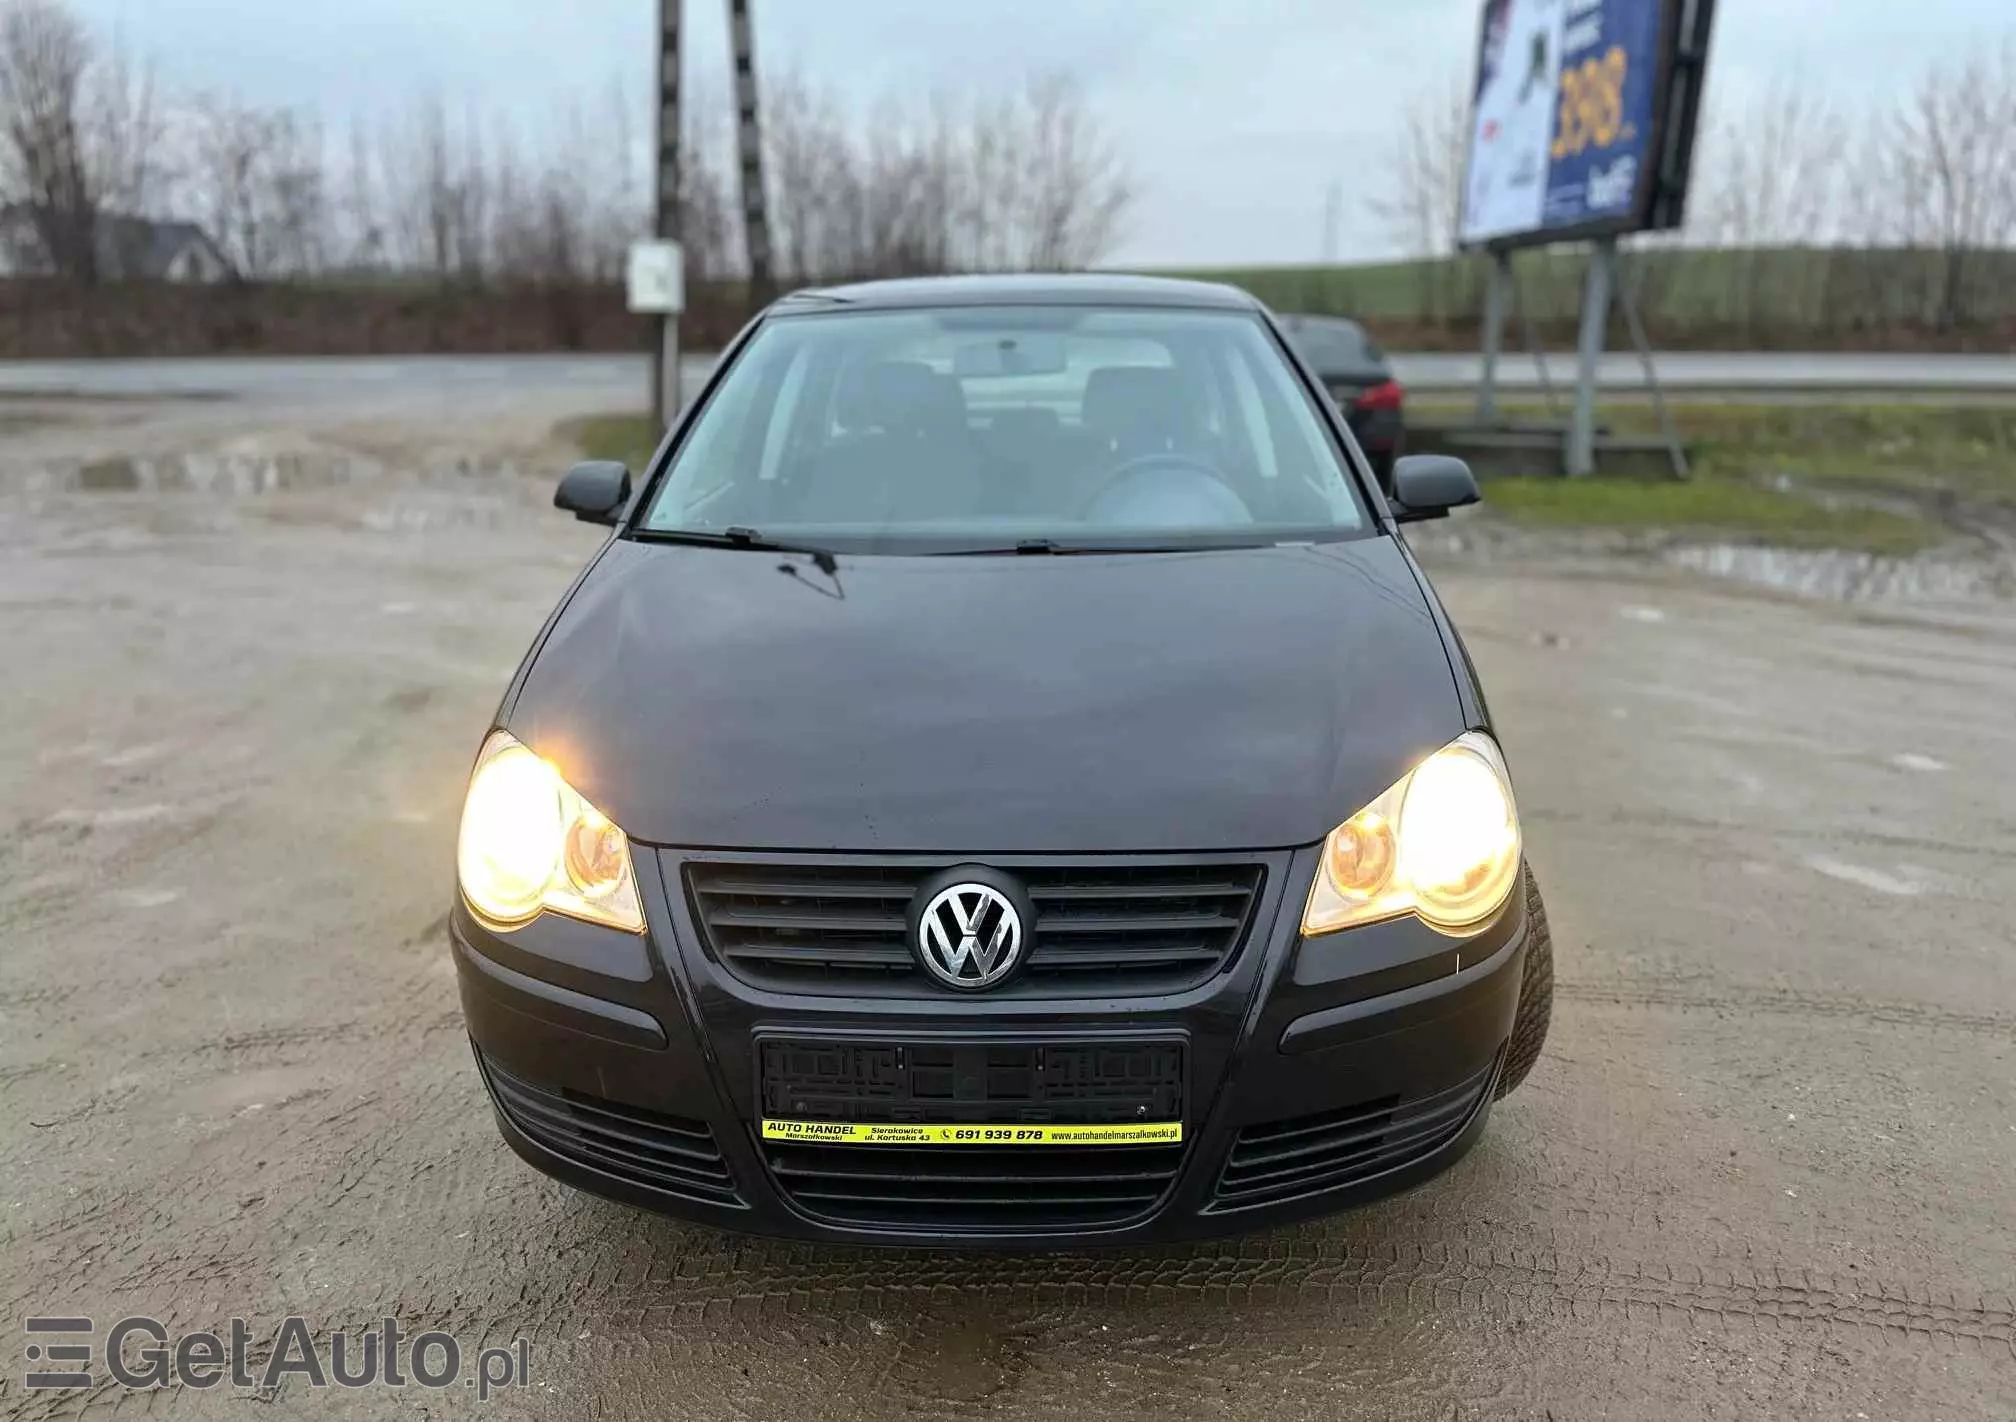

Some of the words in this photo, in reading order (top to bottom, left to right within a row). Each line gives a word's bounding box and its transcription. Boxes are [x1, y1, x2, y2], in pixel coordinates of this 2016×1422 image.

[767, 1122, 801, 1132] AUTO
[805, 1124, 857, 1135] HANDEL
[955, 1130, 981, 1139] 691
[984, 1130, 1012, 1139] 939
[1015, 1130, 1043, 1139] 878
